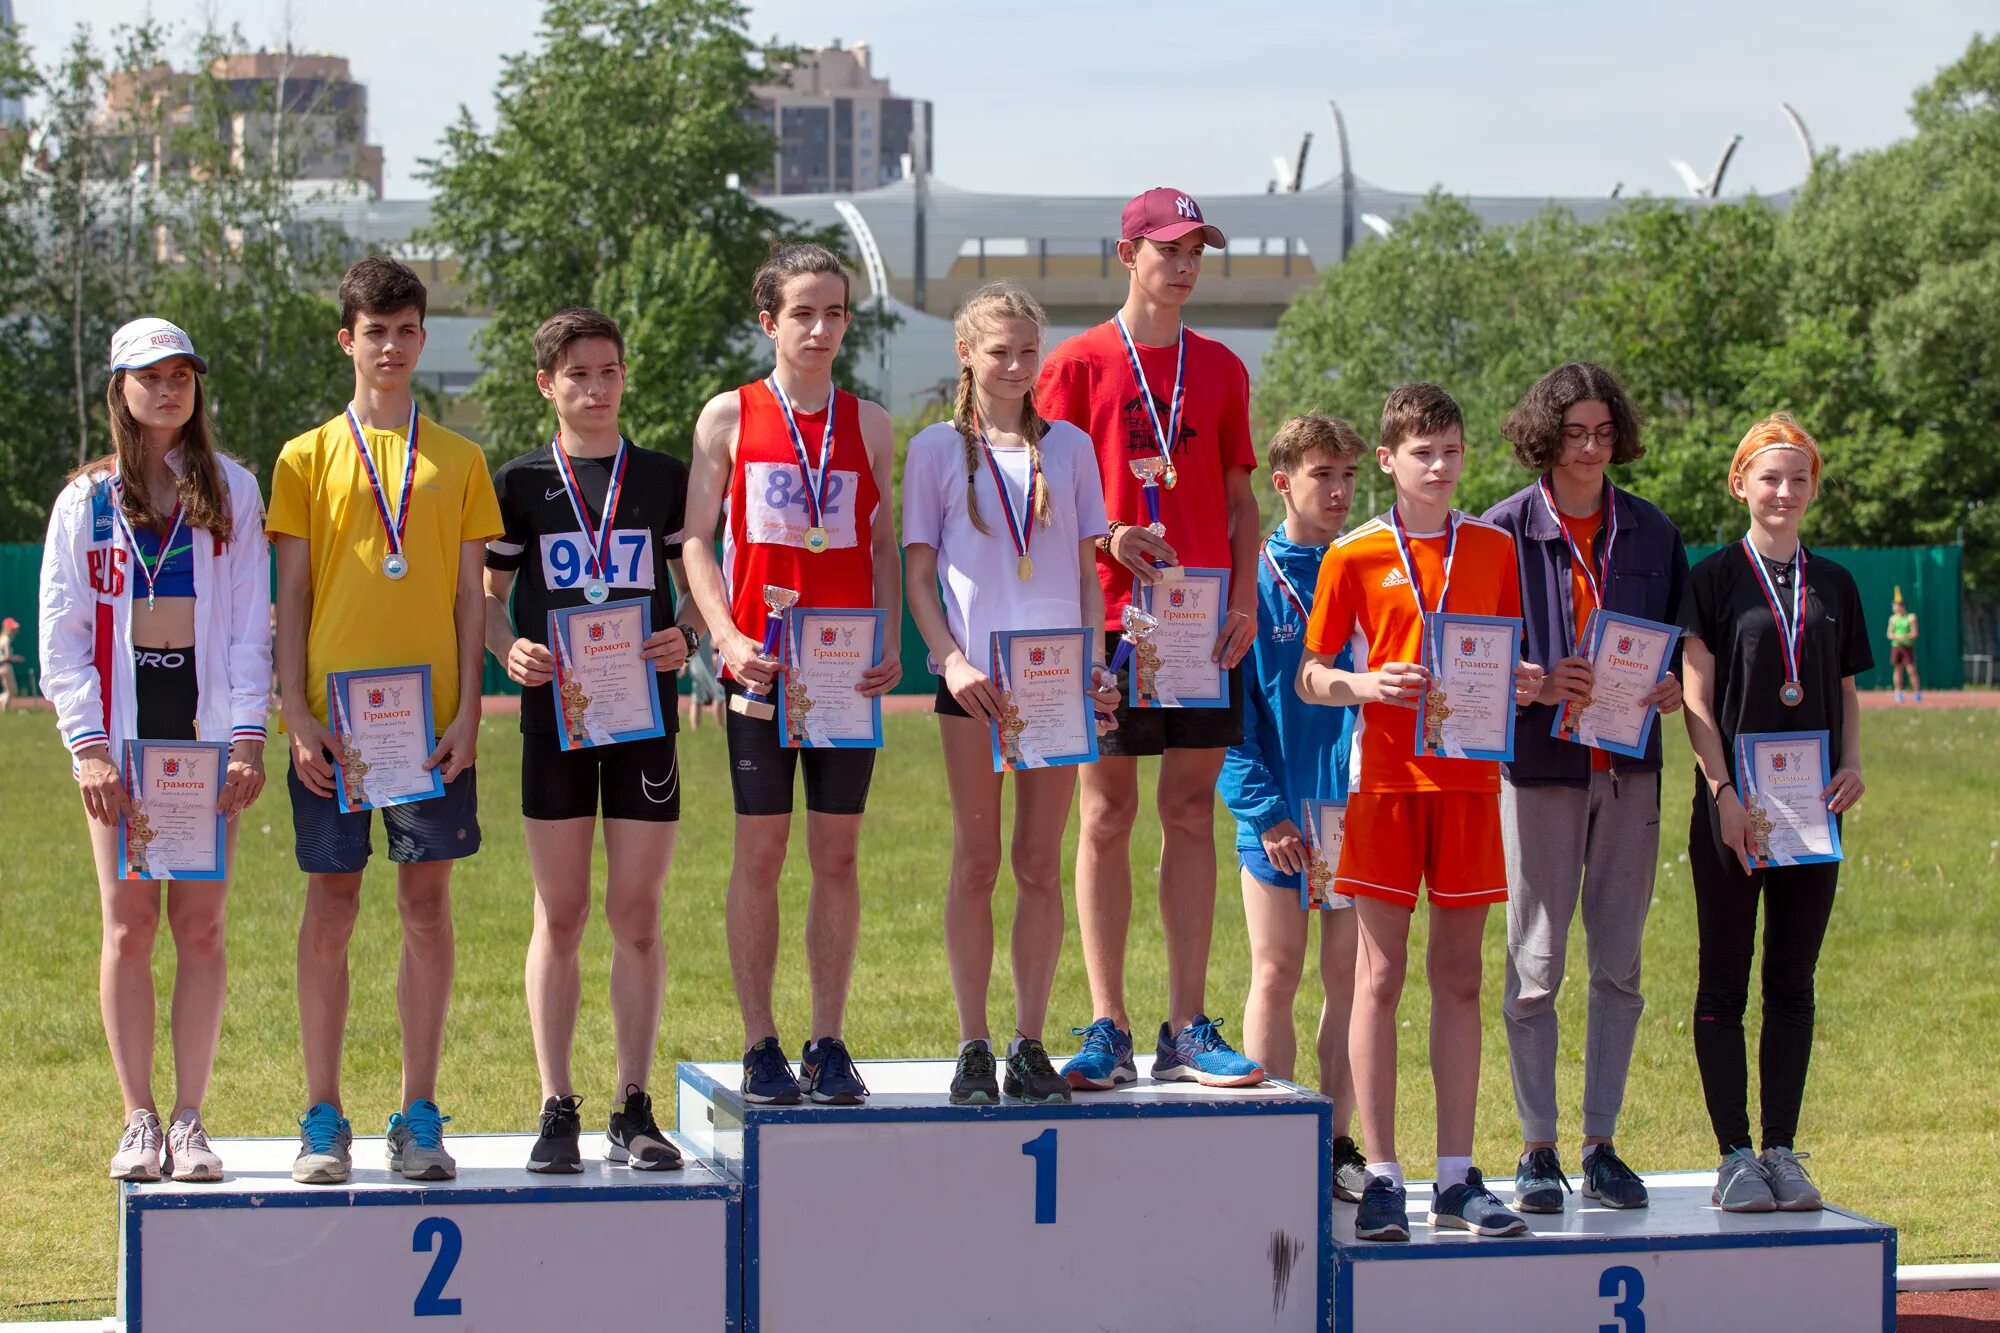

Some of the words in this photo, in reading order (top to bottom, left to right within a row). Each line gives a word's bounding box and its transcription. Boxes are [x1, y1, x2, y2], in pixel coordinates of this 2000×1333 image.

[1175, 196, 1197, 218] NY
[150, 334, 184, 346] RUSSIA
[765, 470, 843, 514] 842
[549, 535, 646, 588] 947
[1382, 577, 1409, 588] adidas
[584, 641, 631, 655] Грамота
[813, 648, 860, 659] Грамота
[1454, 658, 1498, 669] Грамота
[1608, 654, 1649, 670] Грамота
[1023, 668, 1070, 679] Грамота
[363, 710, 411, 722] Грамота
[156, 779, 205, 790] Грамота
[1022, 1128, 1057, 1224] 1
[413, 1217, 462, 1316] 2
[1599, 1265, 1645, 1333] 3
